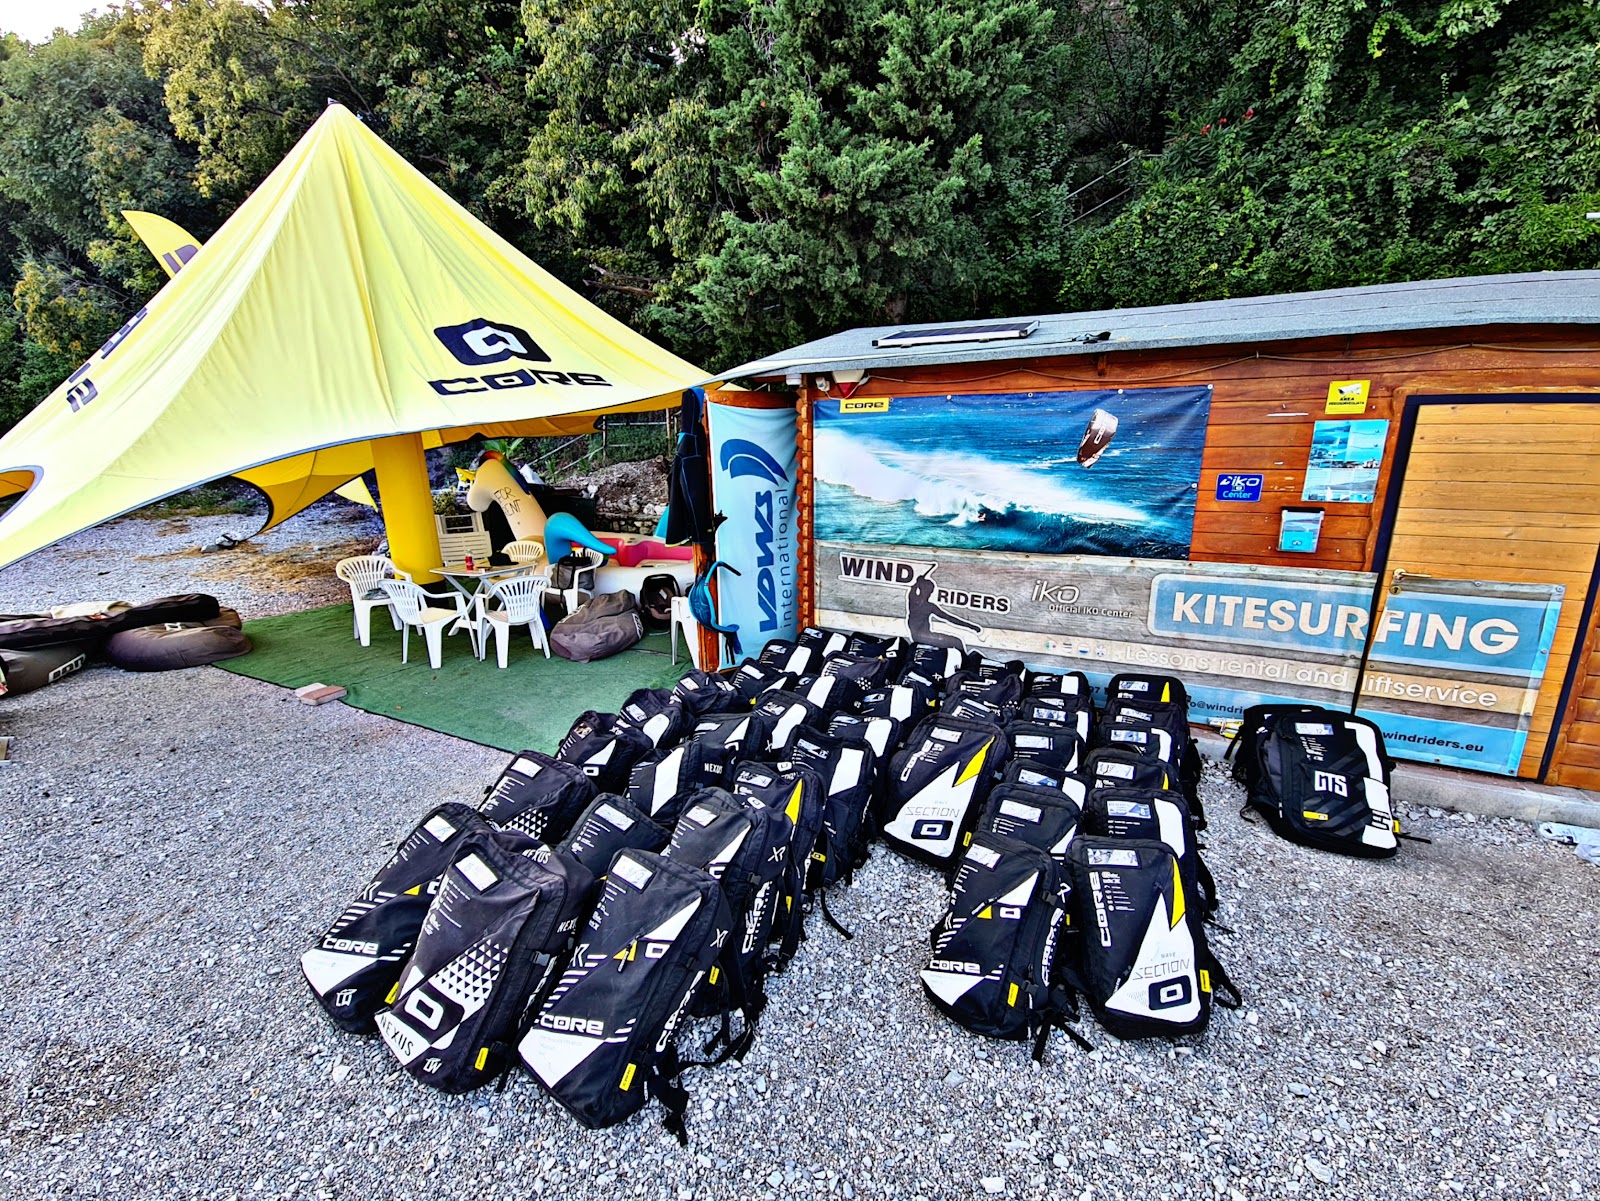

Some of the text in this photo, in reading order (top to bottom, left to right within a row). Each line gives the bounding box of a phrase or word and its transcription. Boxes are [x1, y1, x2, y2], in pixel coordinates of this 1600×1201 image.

[428, 369, 613, 396] CORE
[844, 400, 885, 410] CORE
[494, 487, 516, 501] FOR
[1222, 490, 1252, 499] Center
[775, 487, 793, 629] international
[841, 557, 915, 584] WIND
[937, 589, 1009, 613] RIDERS
[1049, 604, 1133, 619] Official IKO Center
[1171, 591, 1520, 655] KITESURFING
[1125, 645, 1498, 708] Lessons rental and liftservice
[1314, 770, 1348, 797] GTS
[905, 806, 960, 818] SECTION
[1088, 871, 1112, 948] CORE
[322, 937, 380, 955] CORE
[1161, 951, 1176, 959] WAVE
[929, 960, 981, 974] CORE
[1132, 958, 1190, 981] SECTION
[379, 1014, 415, 1057] NEXUS
[540, 1014, 604, 1036] CORE
